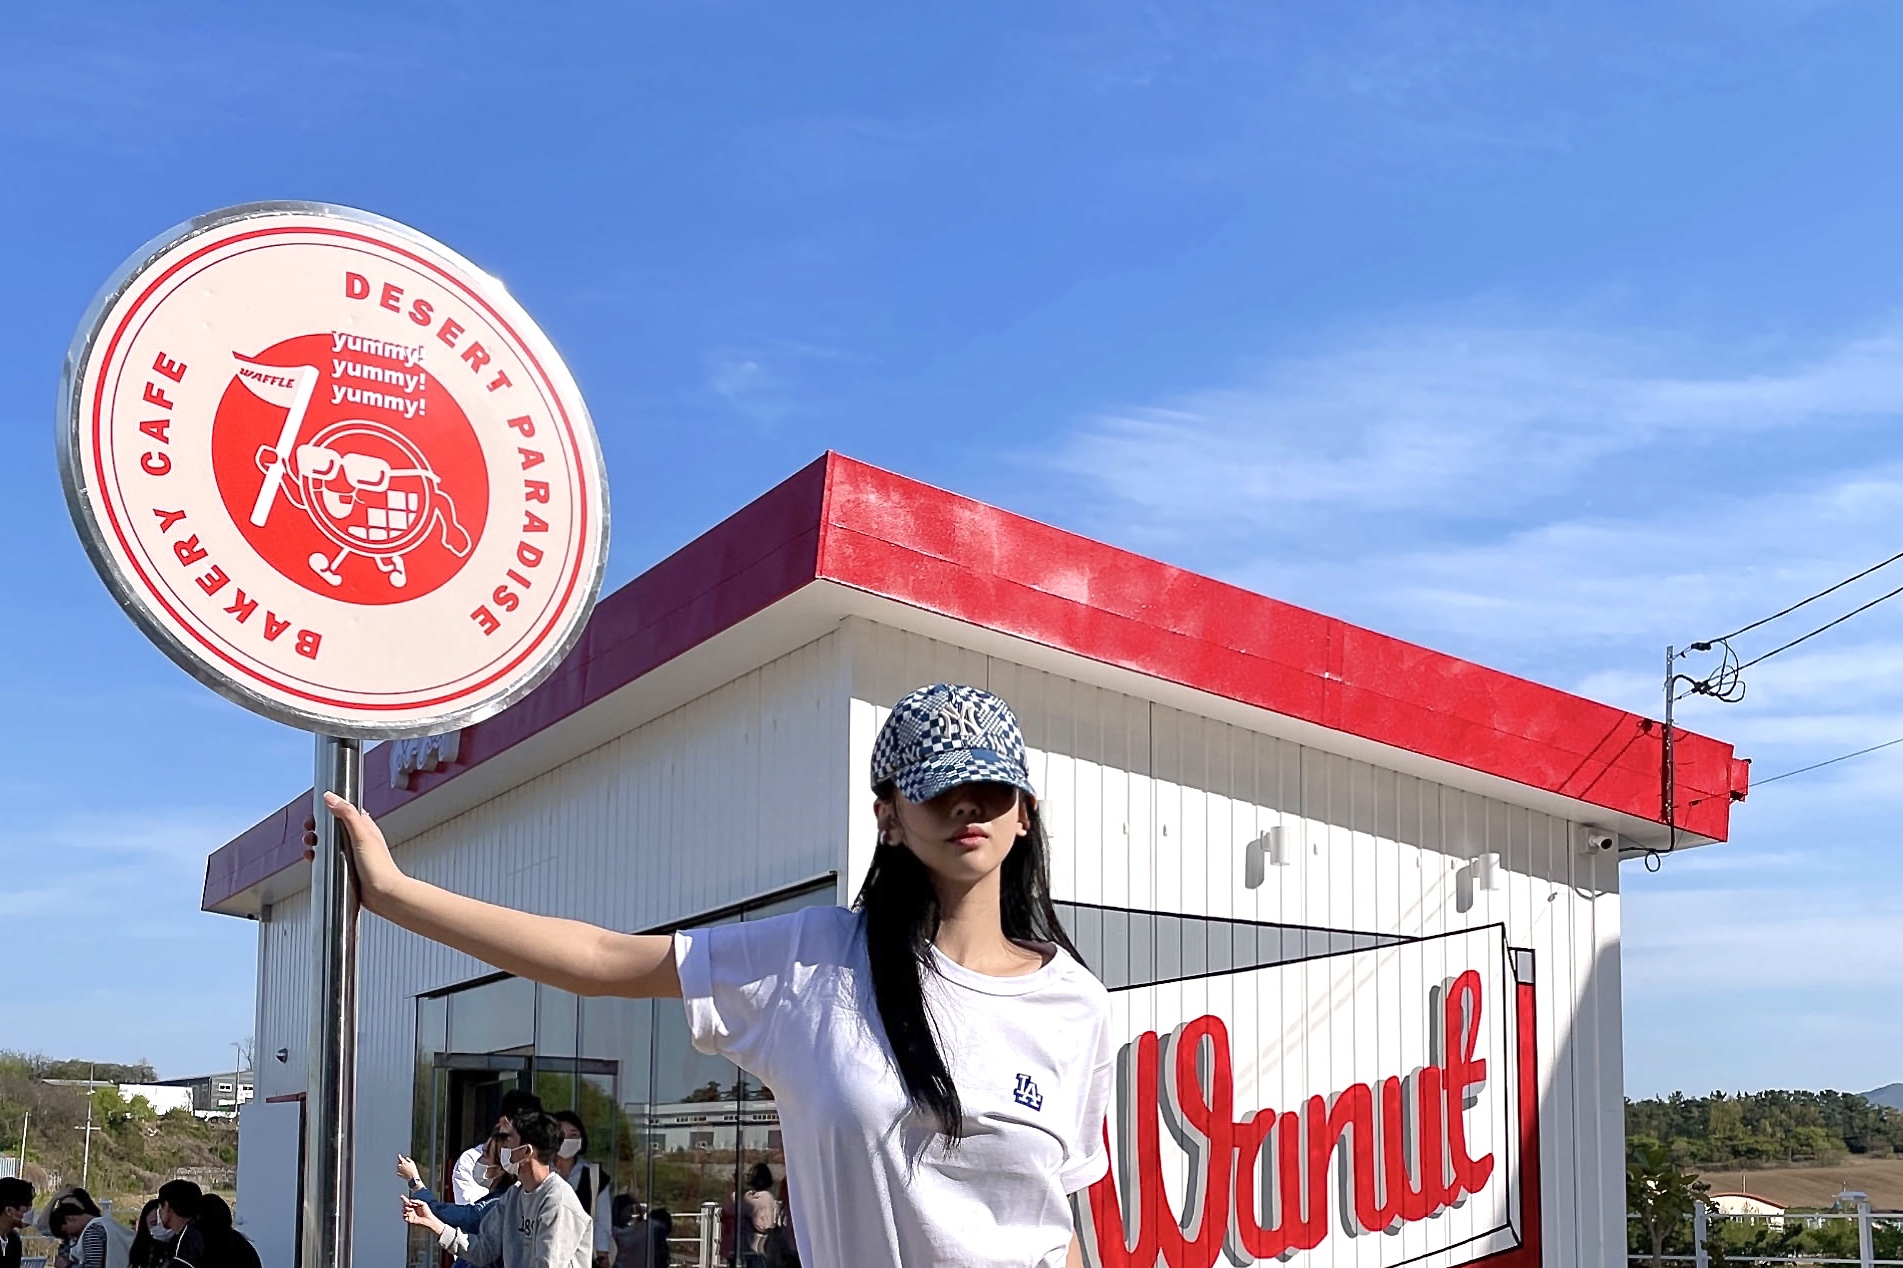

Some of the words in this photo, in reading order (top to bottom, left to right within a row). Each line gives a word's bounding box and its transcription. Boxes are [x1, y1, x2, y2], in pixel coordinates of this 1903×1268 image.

[331, 330, 426, 367] yummy!
[239, 367, 296, 389] WAFFLE
[331, 358, 426, 393] yummy!
[139, 351, 187, 477] CAFE
[331, 384, 426, 419] yummy!
[345, 271, 512, 394] DESERT
[470, 414, 550, 636] PARADISE
[153, 507, 322, 660] BAKERY
[1013, 1072, 1044, 1112] LA
